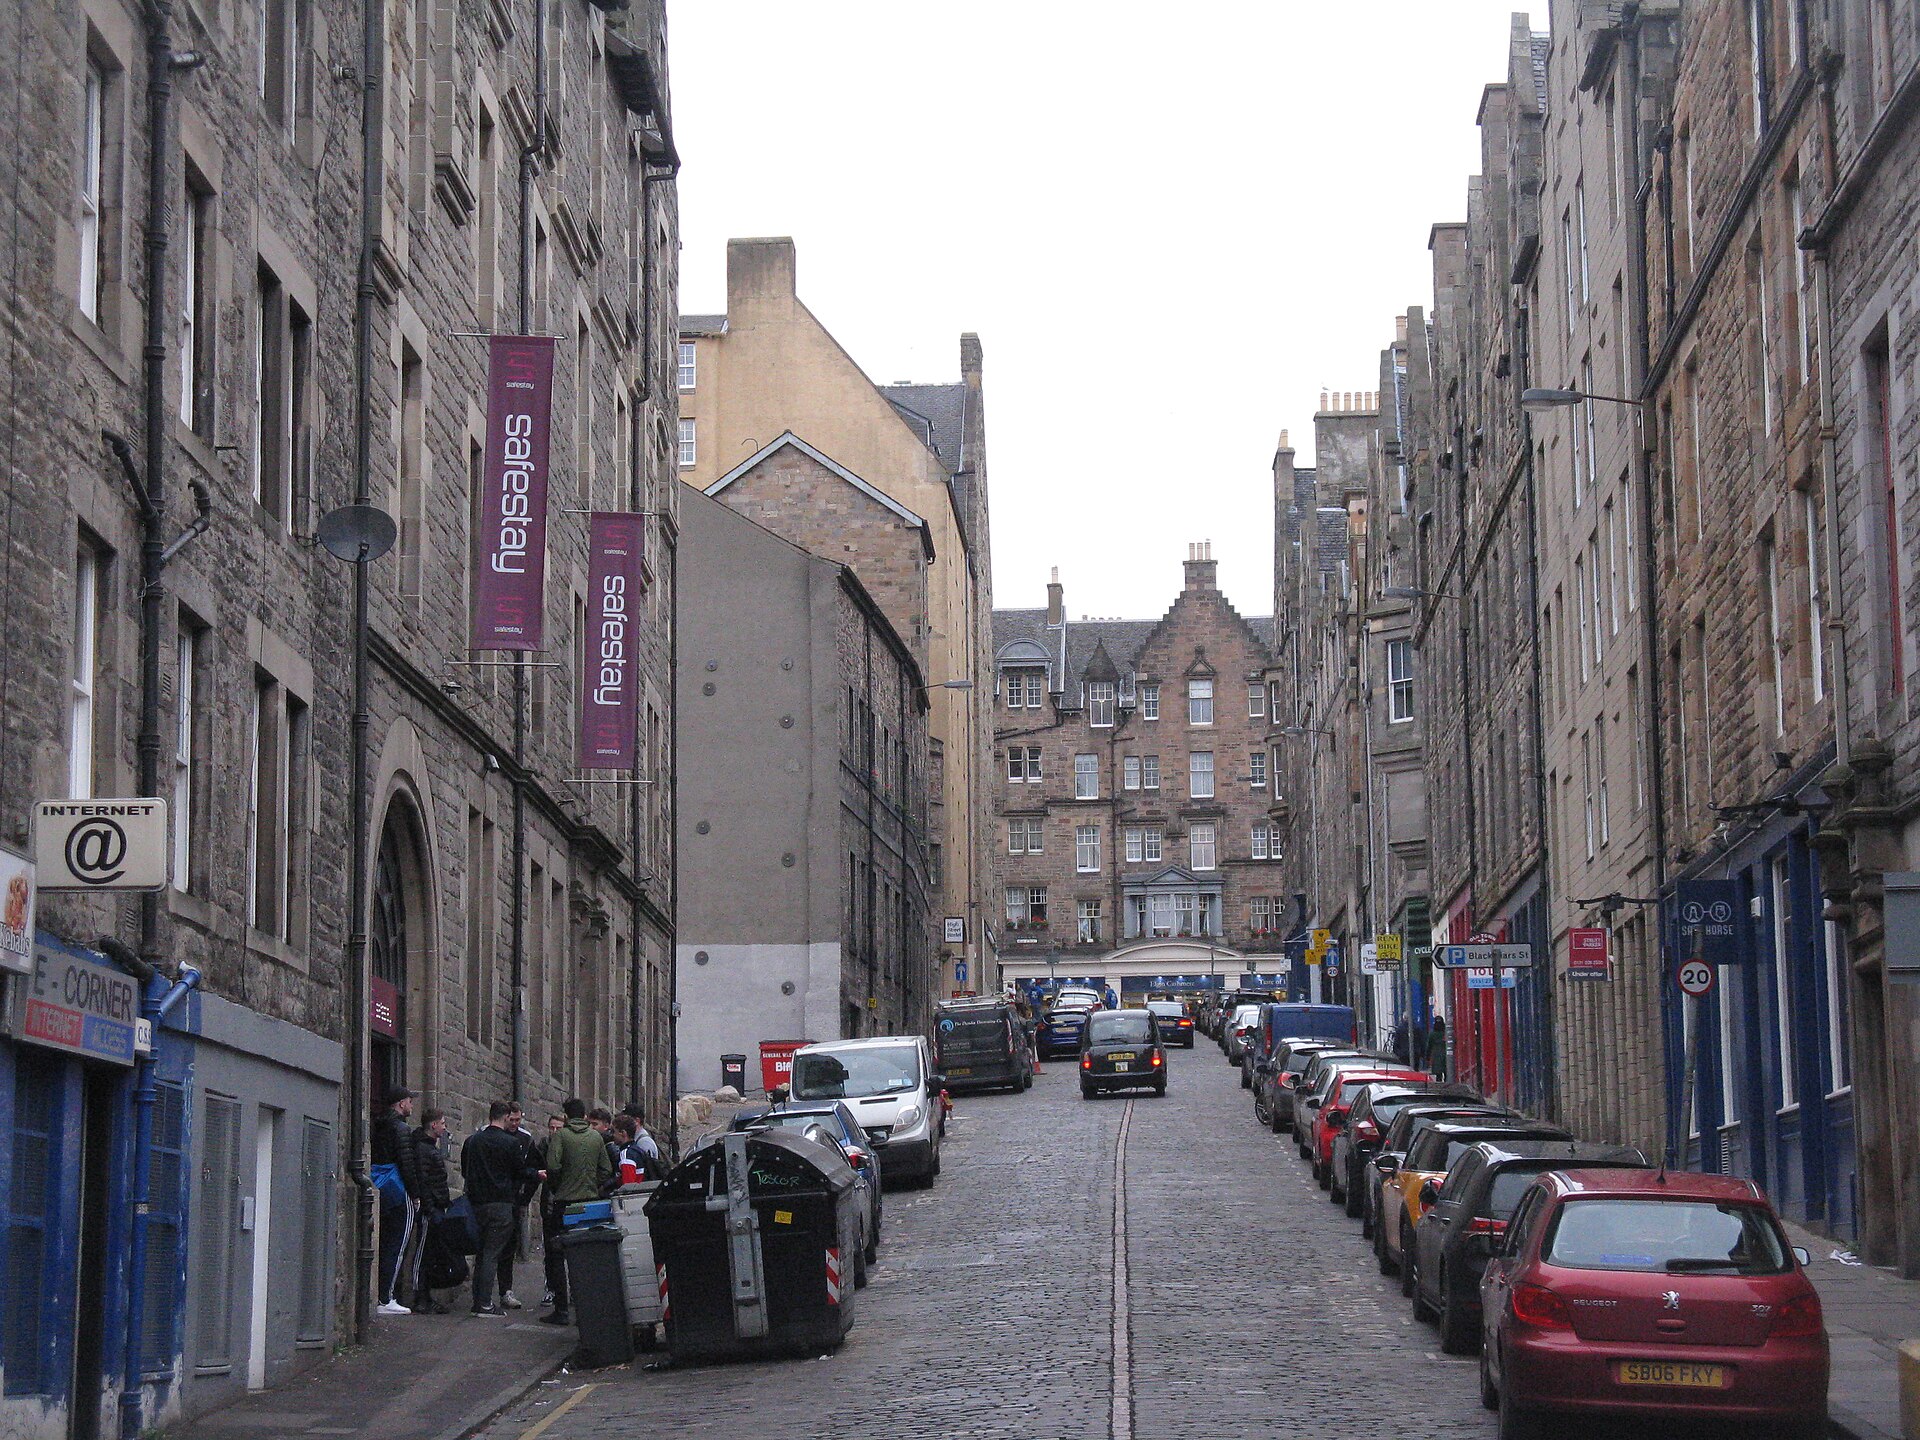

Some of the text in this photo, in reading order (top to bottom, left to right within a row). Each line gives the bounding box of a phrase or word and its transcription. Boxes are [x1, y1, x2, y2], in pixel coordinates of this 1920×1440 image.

[491, 413, 535, 573] safestay
[594, 575, 628, 706] safestay
[42, 805, 154, 816] INTERNET
[65, 817, 127, 884] @
[1705, 924, 1734, 936] HORSE
[1518, 951, 1529, 959] St
[1489, 968, 1507, 976] LT
[1683, 969, 1709, 984] 20
[64, 965, 132, 1022] CORNER
[1573, 1299, 1617, 1307] PEUGEOT
[1751, 1304, 1772, 1312] 307
[1628, 1364, 1715, 1383] SB06 FKY
